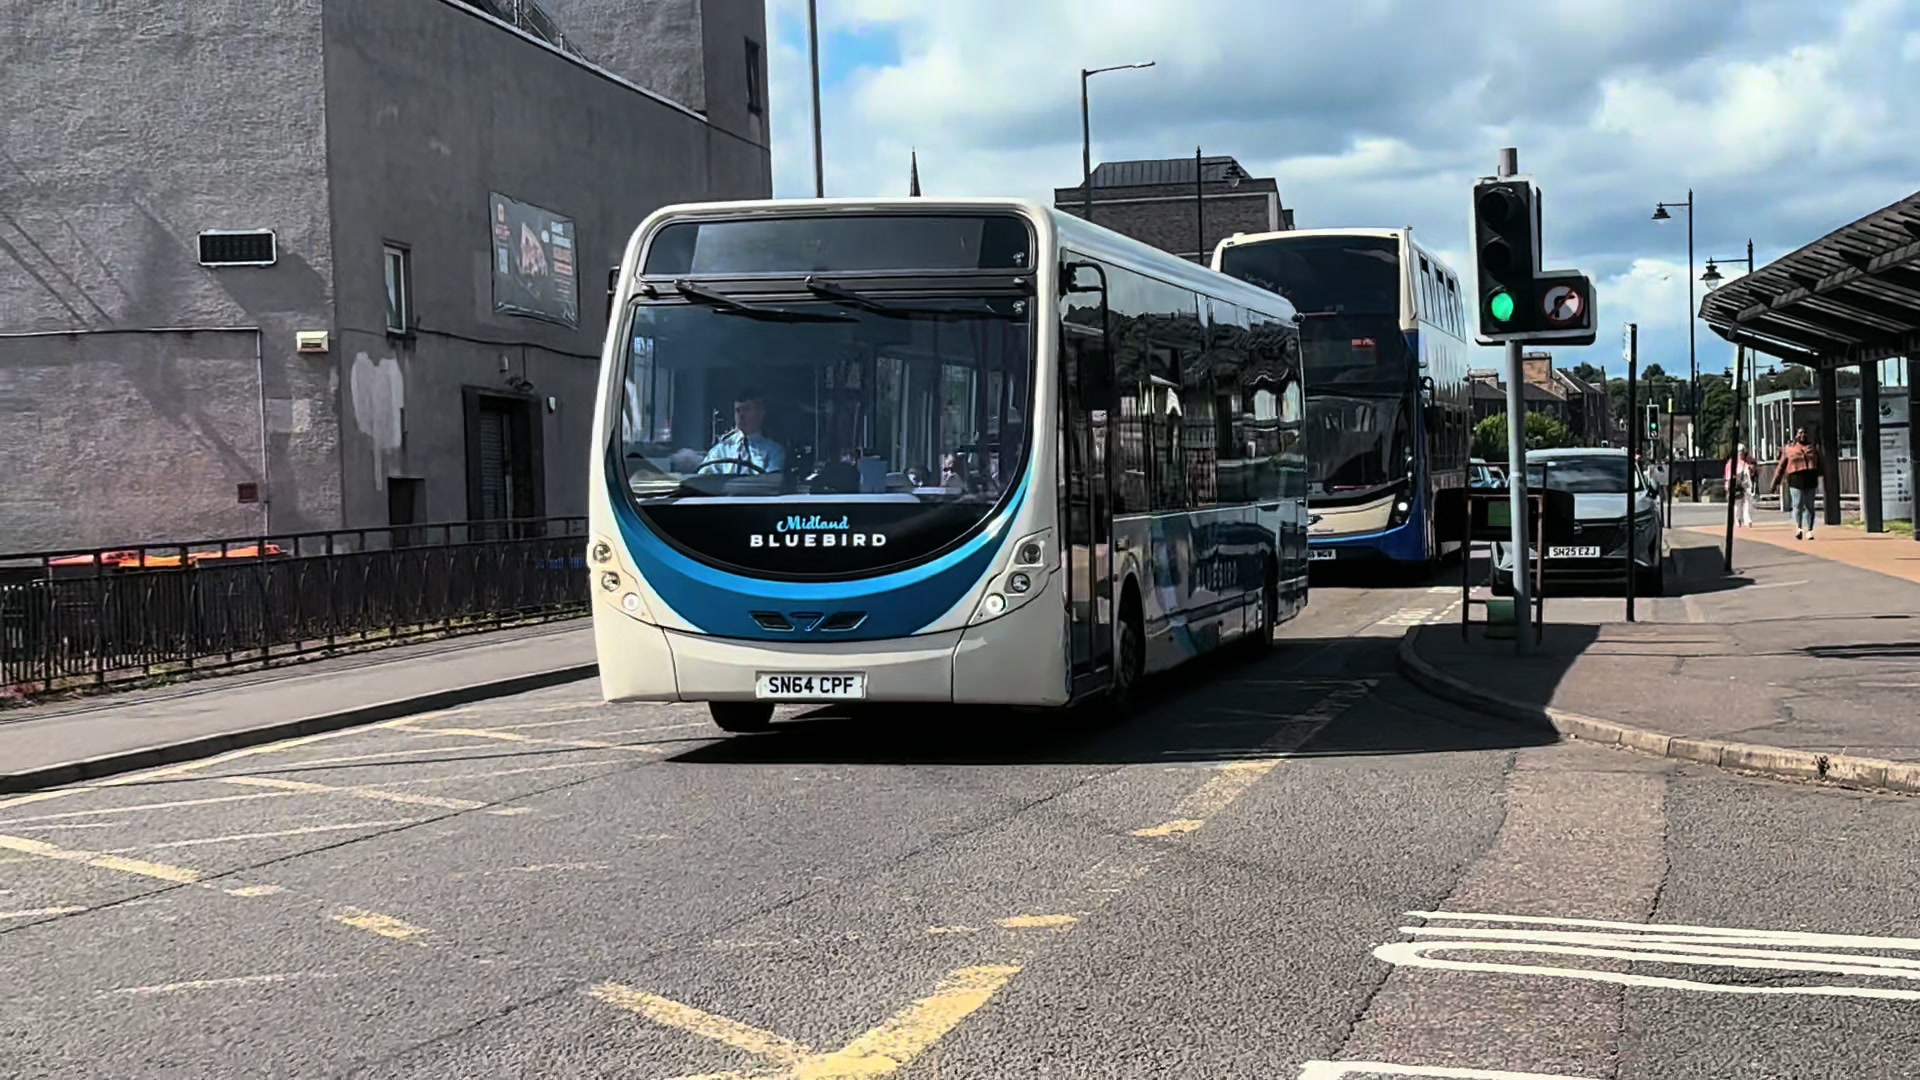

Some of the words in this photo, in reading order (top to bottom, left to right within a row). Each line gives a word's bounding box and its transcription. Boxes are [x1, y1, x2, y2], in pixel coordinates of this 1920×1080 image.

[776, 515, 850, 532] Midland
[750, 534, 887, 547] BLUEBIRD
[769, 676, 814, 694] SN64
[820, 676, 855, 694] CPF
